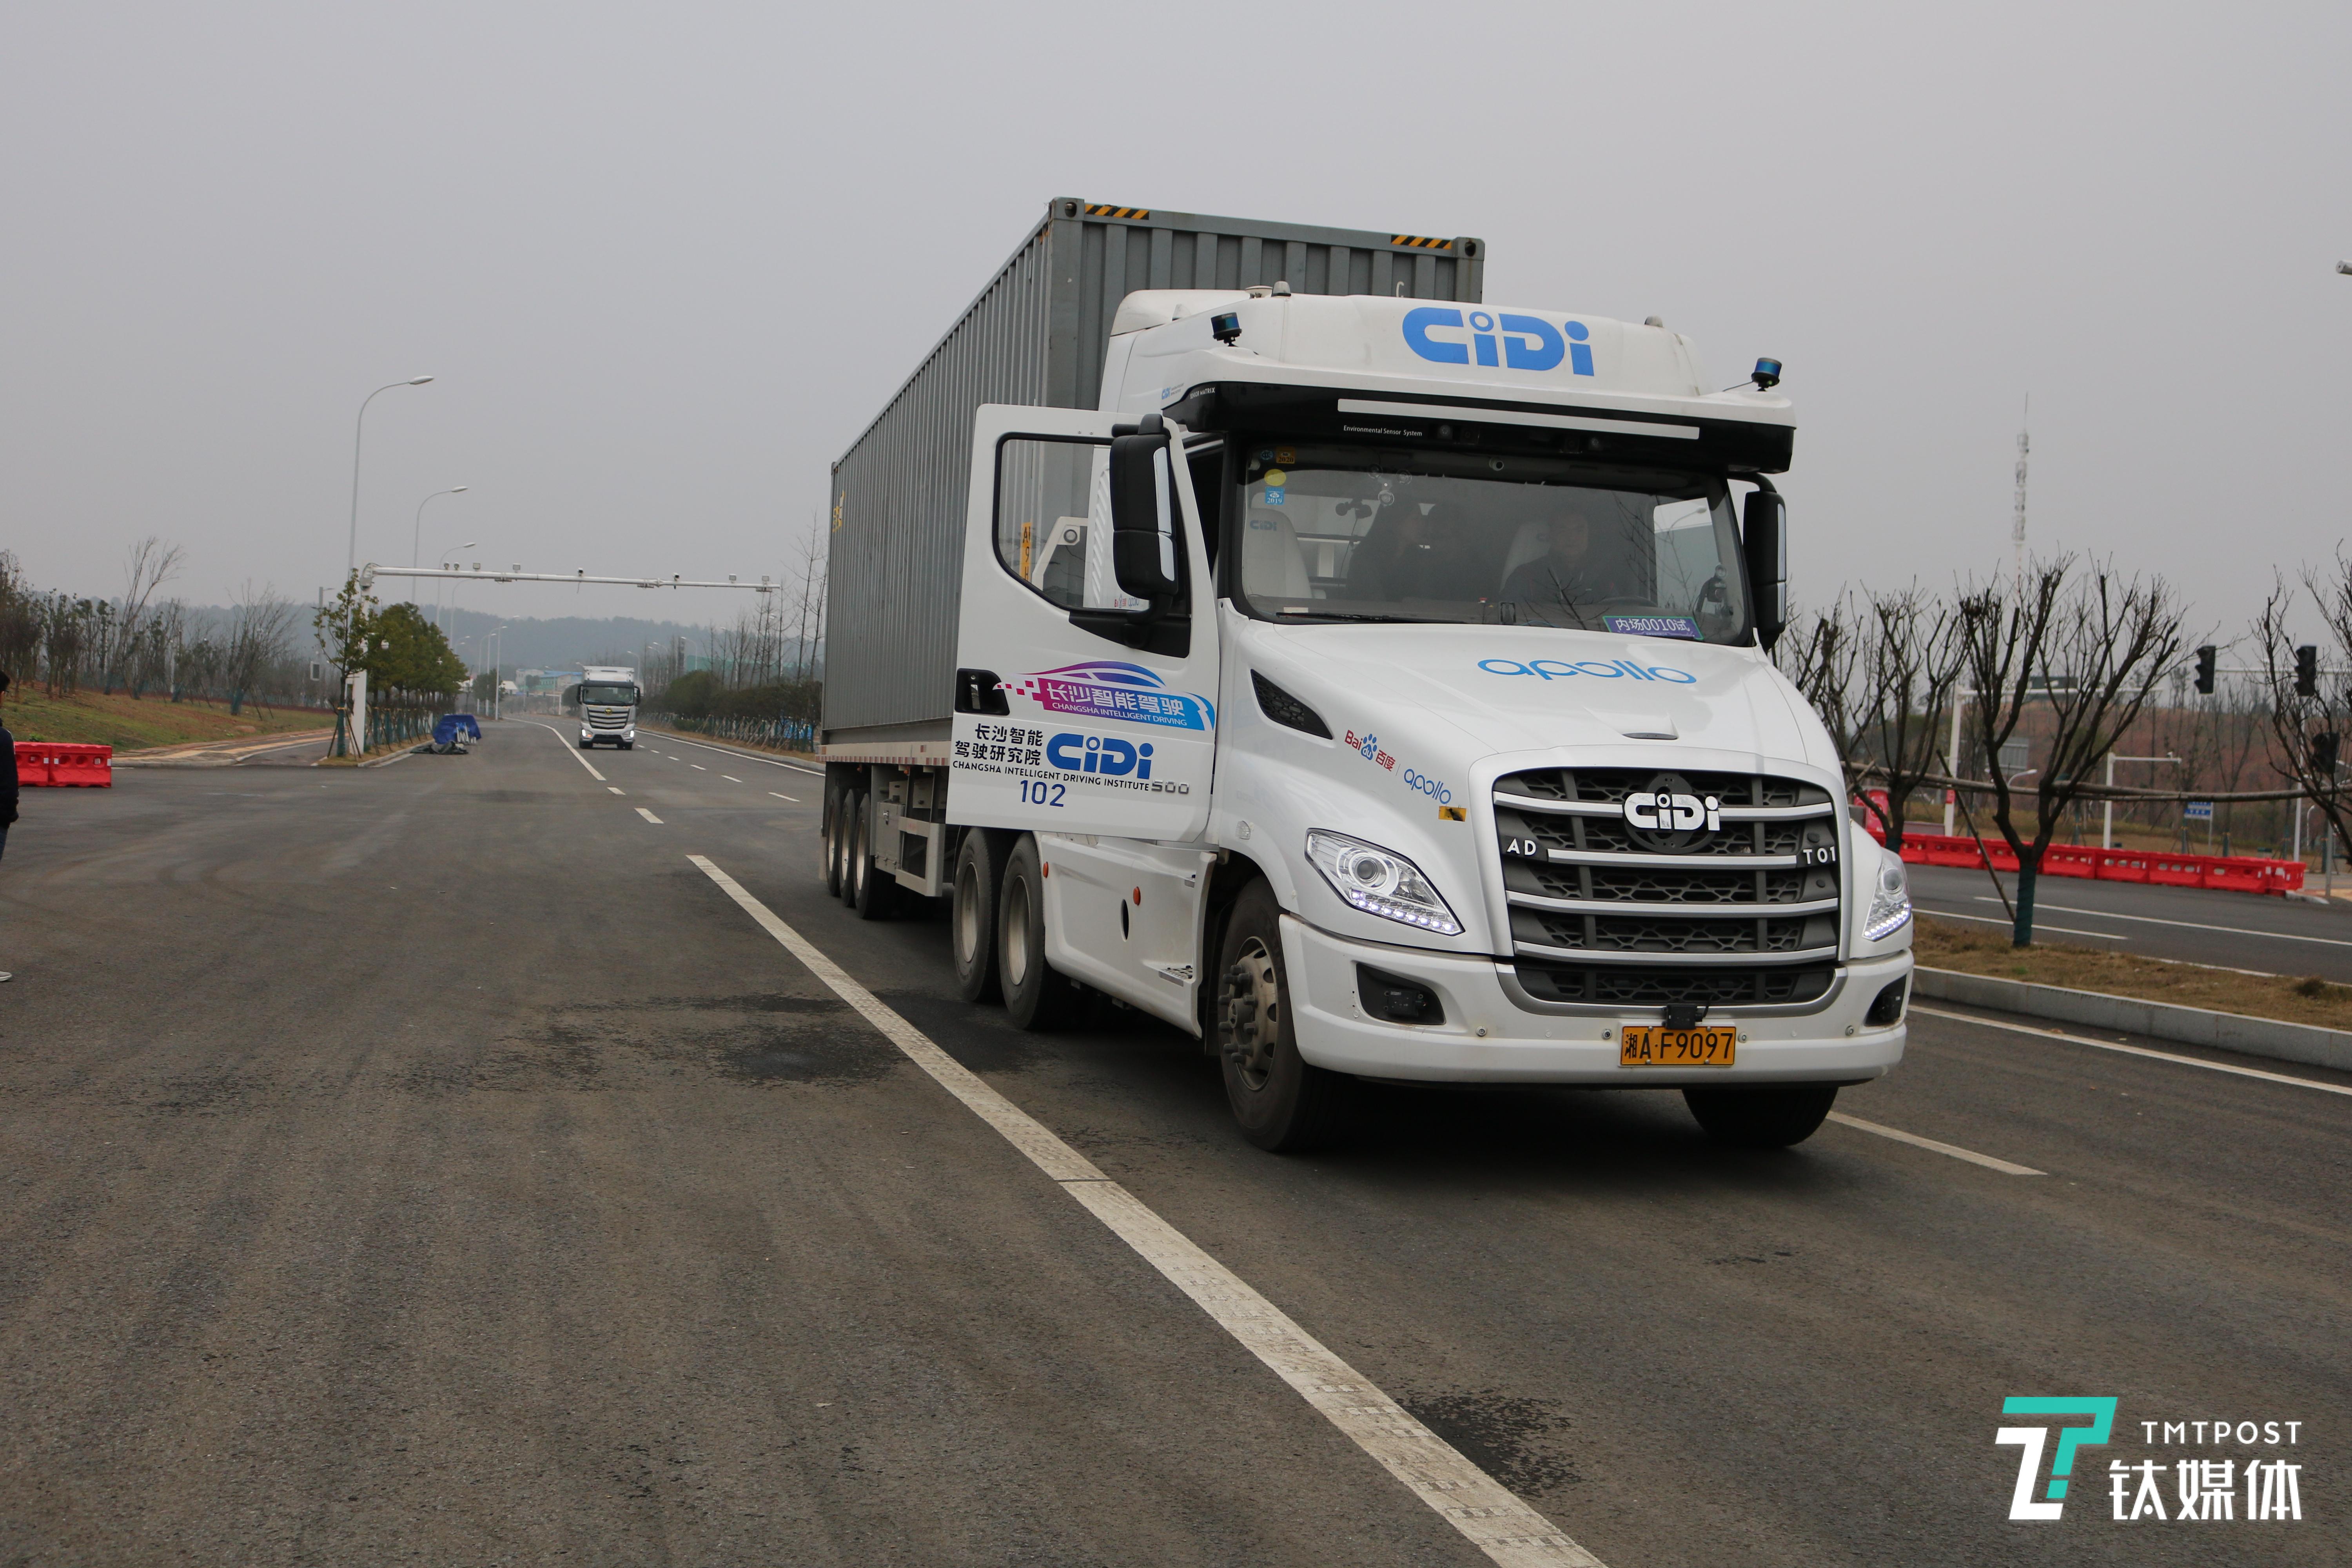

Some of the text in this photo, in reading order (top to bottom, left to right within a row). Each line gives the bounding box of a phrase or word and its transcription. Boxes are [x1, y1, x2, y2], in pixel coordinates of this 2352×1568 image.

[1200, 387, 1215, 395] MATRIX
[1343, 425, 1382, 434] Environmental
[1615, 618, 1690, 632] 内场0010试
[1477, 659, 1697, 684] apollo
[1047, 682, 1185, 717] 长沙智能驾驶
[1052, 702, 1187, 726] CHANGSHA INTELLIGENT DRIVING
[975, 723, 1043, 746] 长沙智能
[955, 740, 1041, 766] 驾驶研究院
[953, 760, 1149, 791] CHANGSHA INTELLIGENT DRIVING INSTITUTE
[1151, 779, 1190, 795] 500
[1375, 750, 1396, 772] 百度
[1404, 769, 1451, 804] apollo
[1020, 780, 1066, 807] 102
[1506, 838, 1537, 856] AD
